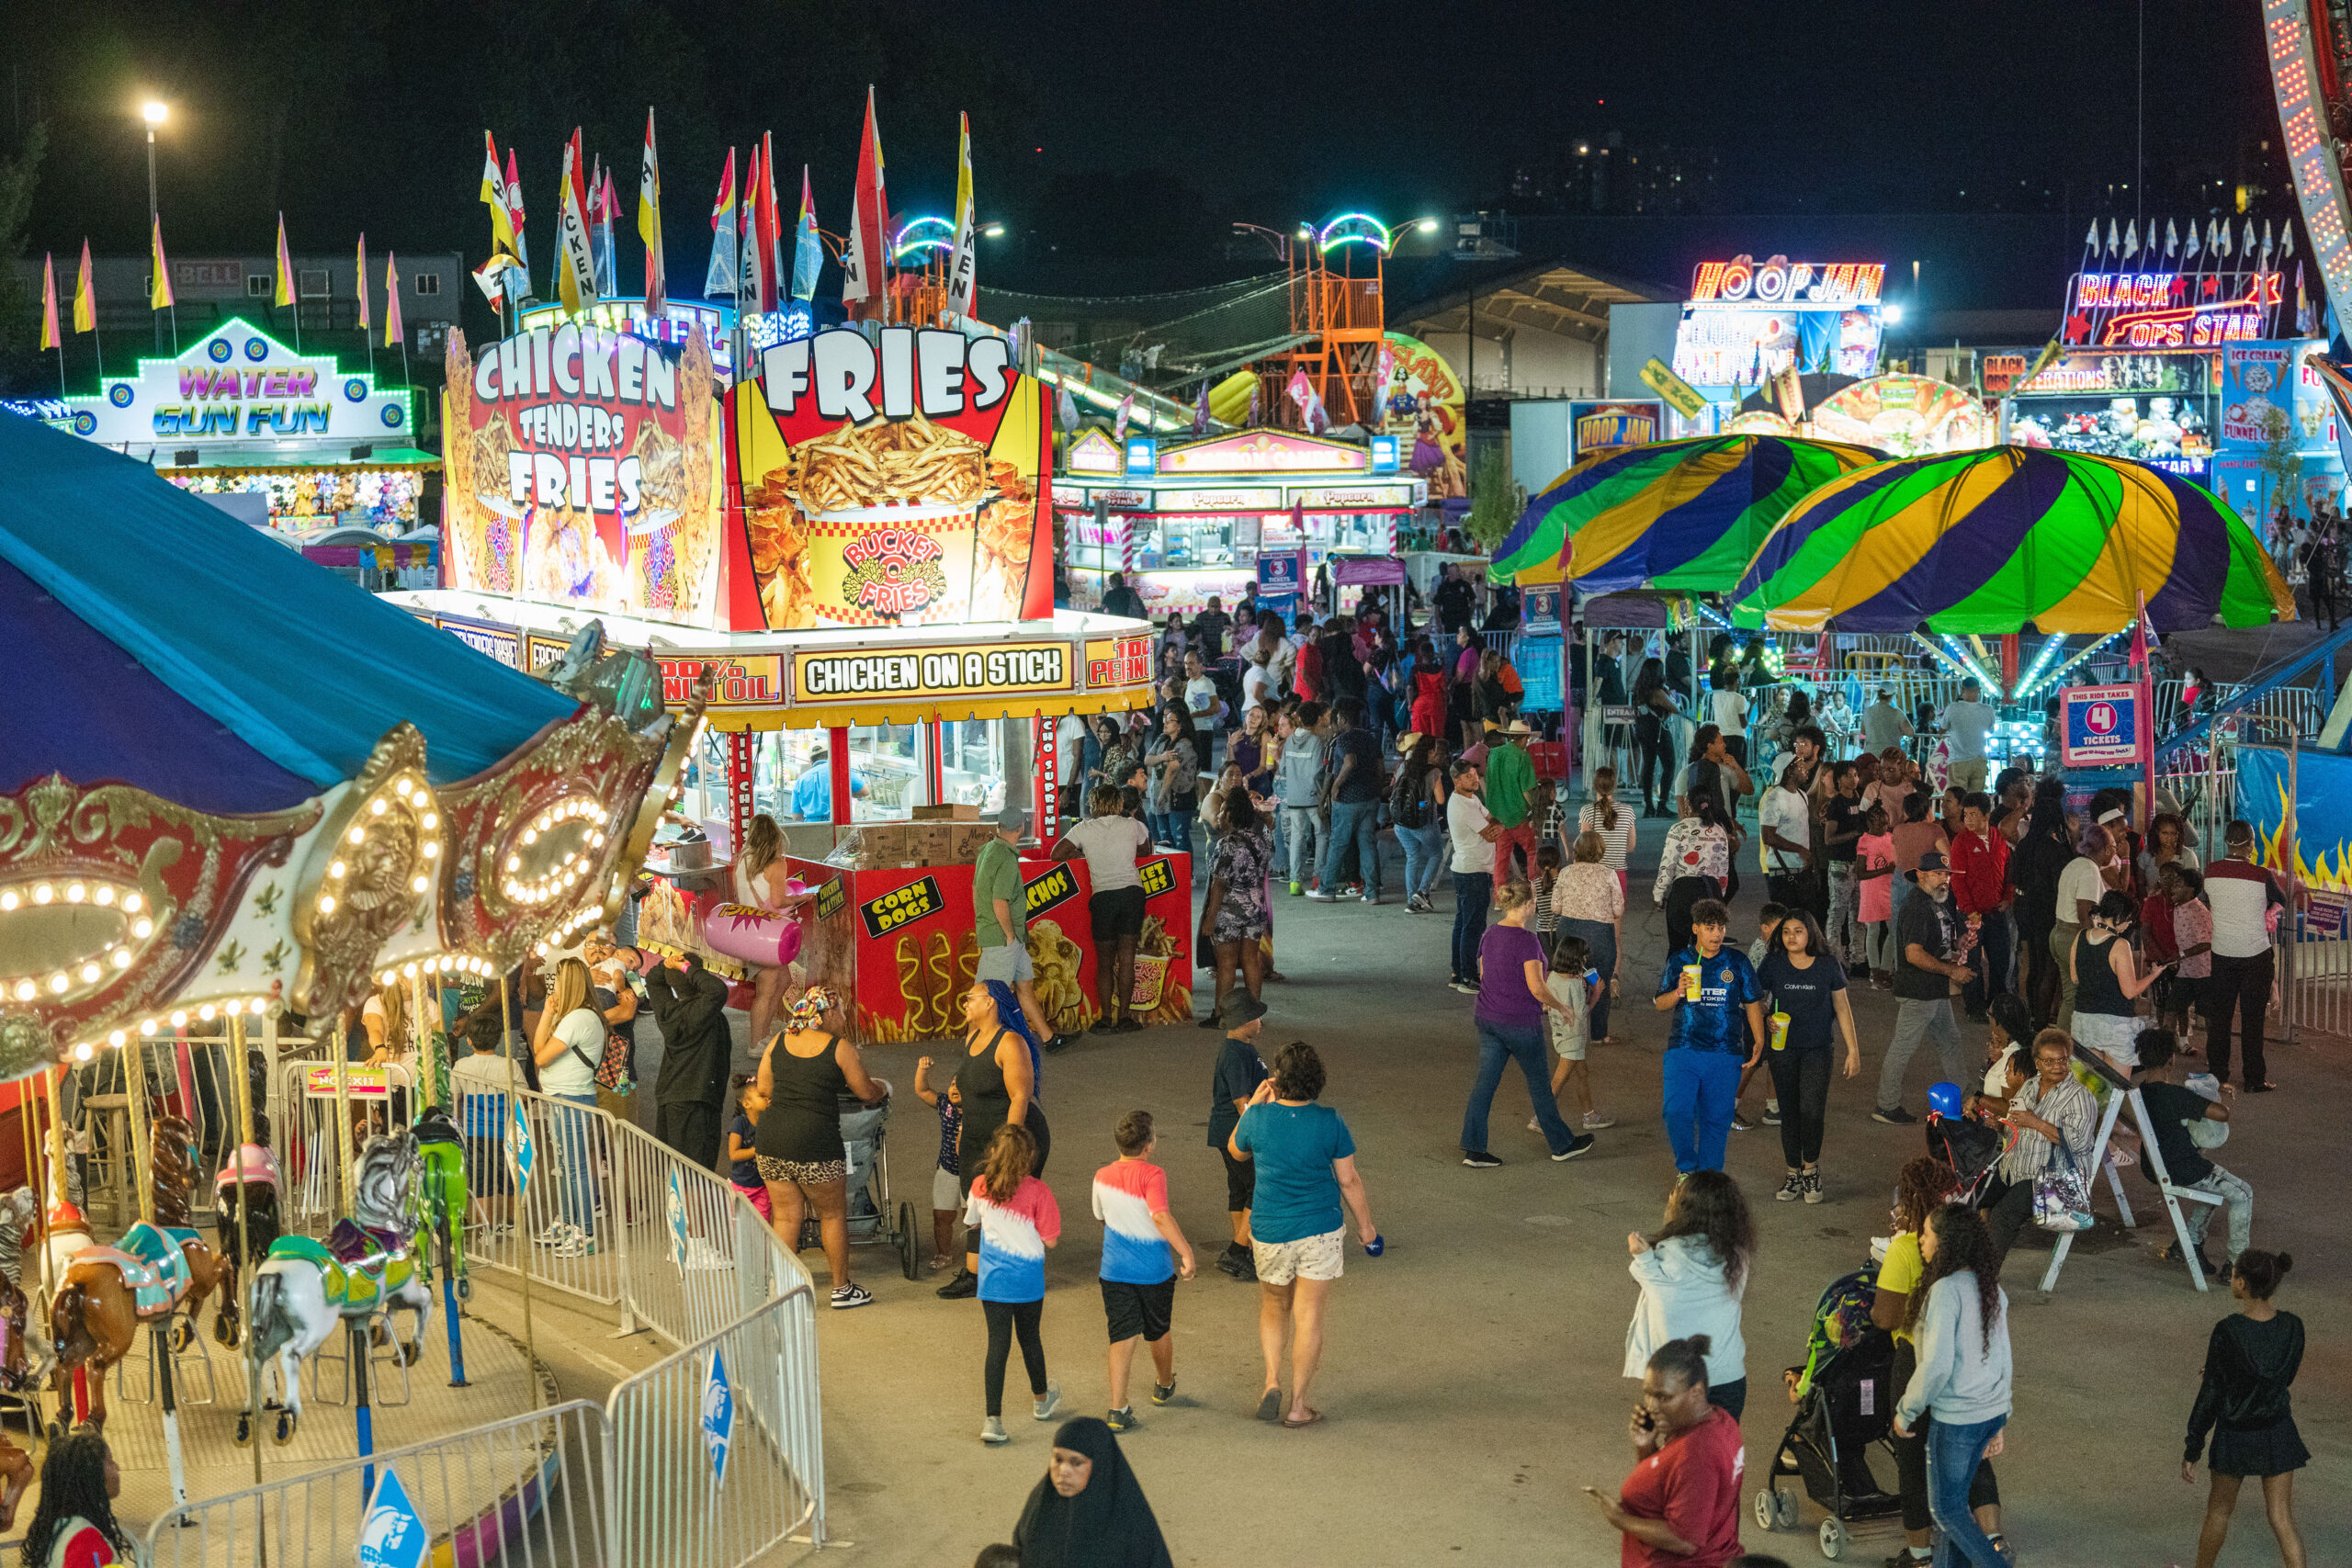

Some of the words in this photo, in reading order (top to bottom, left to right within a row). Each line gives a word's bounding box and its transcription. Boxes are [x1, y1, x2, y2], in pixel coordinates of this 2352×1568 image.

[1691, 263, 1813, 302] HOOP
[1809, 264, 1885, 304] JAM
[2078, 274, 2173, 308] BLACK
[2131, 323, 2184, 347] OPS
[2193, 314, 2260, 345] STAR
[475, 322, 675, 412] CHICKEN
[1986, 357, 2024, 374] BLACK
[2232, 350, 2247, 361] ICE
[2249, 350, 2283, 361] CREAM
[177, 365, 318, 400] WATER
[762, 327, 1010, 426] FRIES
[1986, 375, 2009, 390] OPS
[152, 402, 242, 437] GUN
[245, 401, 333, 436] FUN
[519, 401, 624, 453] TENDERS
[1582, 417, 1620, 448] HOOP
[1622, 417, 1652, 445] JAM
[2223, 423, 2258, 441] FUNNEL
[2260, 425, 2290, 443] CES
[508, 450, 641, 516] FRIES
[1192, 492, 1244, 506] Popcorn
[1324, 491, 1374, 506] Popcorn
[485, 518, 514, 558] BUCKET
[642, 536, 675, 573] BUCKET
[843, 528, 944, 571] BUCKET
[1272, 561, 1284, 575] 3
[858, 578, 932, 619] FRIES
[1538, 595, 1548, 613] 3
[493, 636, 519, 671] BASKET
[654, 659, 746, 679] 00%
[724, 675, 780, 702] OIL
[806, 655, 920, 695] CHICKEN
[922, 653, 961, 690] ON
[963, 651, 985, 688] A
[987, 648, 1062, 685] STICK
[2091, 706, 2111, 730] 4
[2083, 735, 2121, 745] TICKETS
[1044, 760, 1057, 838] SUPREME
[820, 878, 841, 901] CHICKEN
[831, 890, 844, 909] STICK
[871, 881, 928, 915] CORN
[1026, 871, 1068, 912] ACHOS
[877, 896, 931, 931] DOGS
[319, 1075, 337, 1086] NO
[346, 1076, 375, 1087] EXIT
